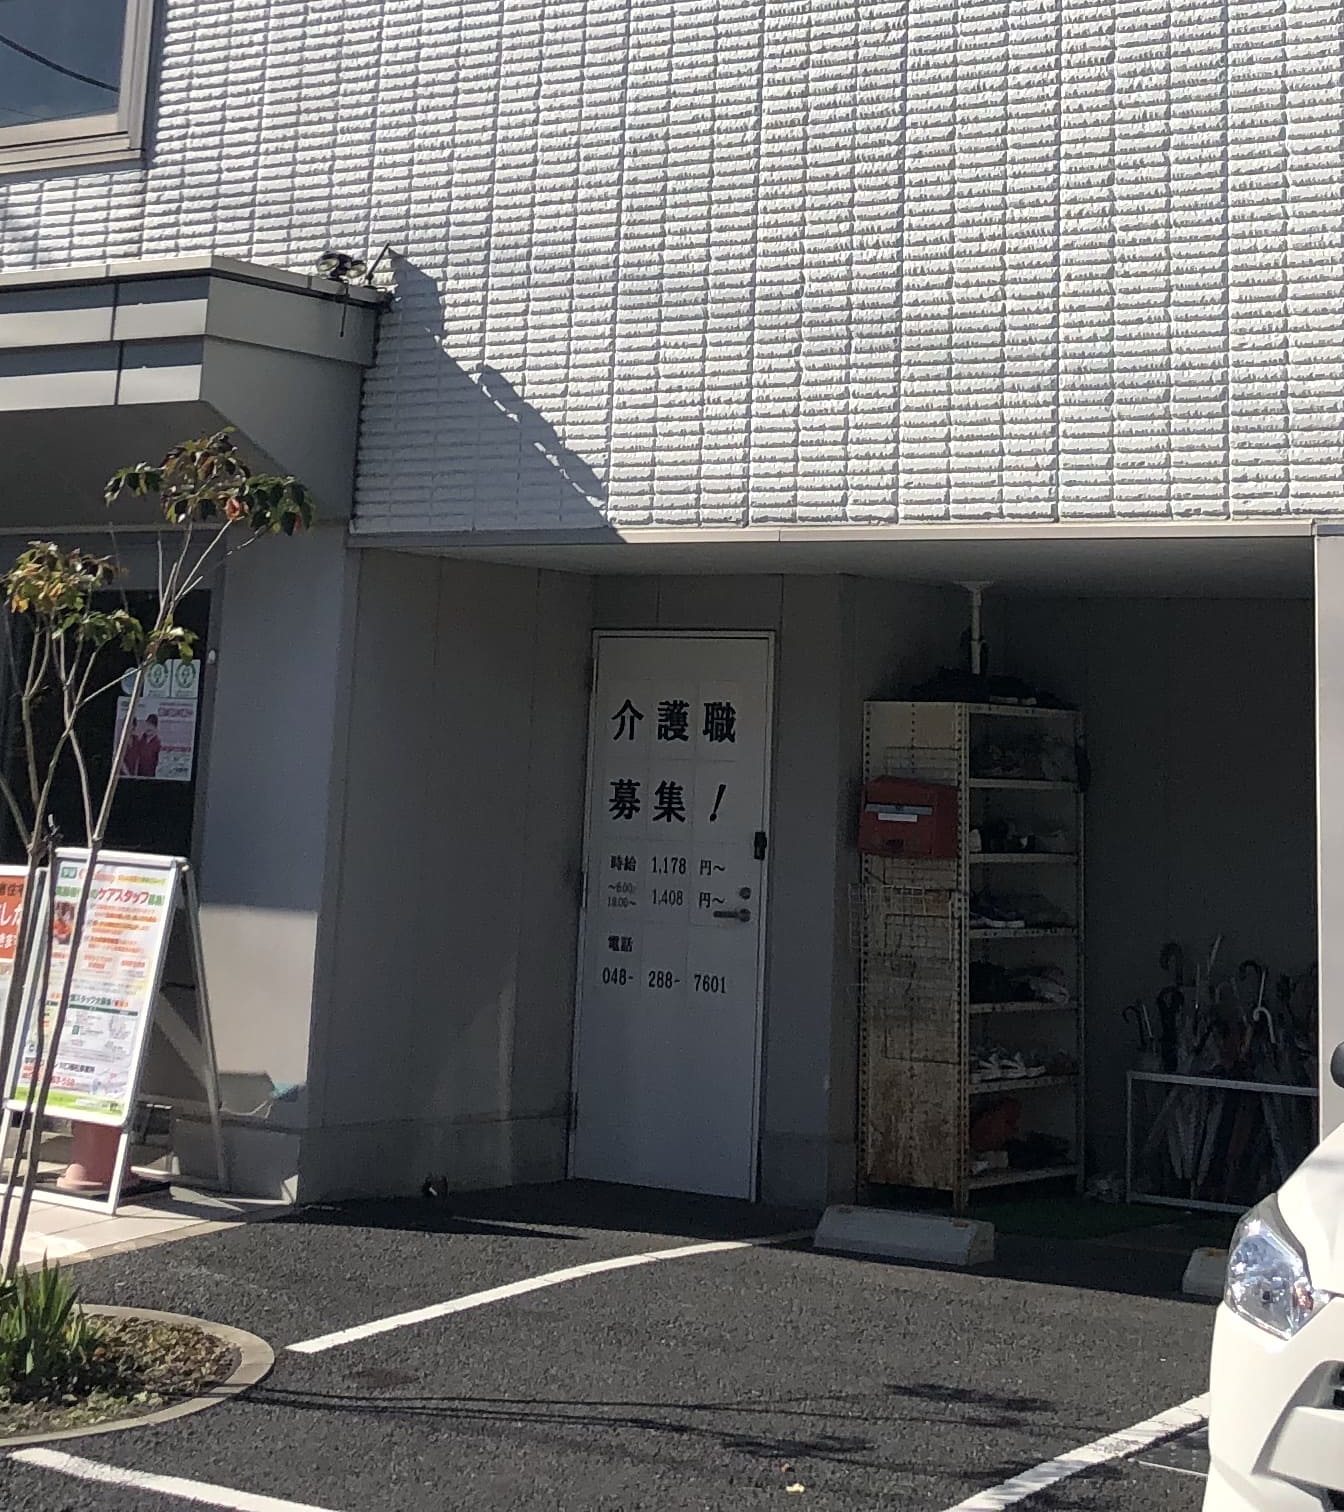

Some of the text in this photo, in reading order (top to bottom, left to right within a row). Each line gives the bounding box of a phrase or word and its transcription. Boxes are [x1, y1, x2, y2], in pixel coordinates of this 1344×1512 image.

[611, 699, 736, 743] 介護職
[610, 855, 637, 872] 時給
[651, 856, 687, 875] 1,178
[652, 889, 683, 906] 1,408
[608, 935, 633, 952] 電話
[694, 974, 726, 994] 7601
